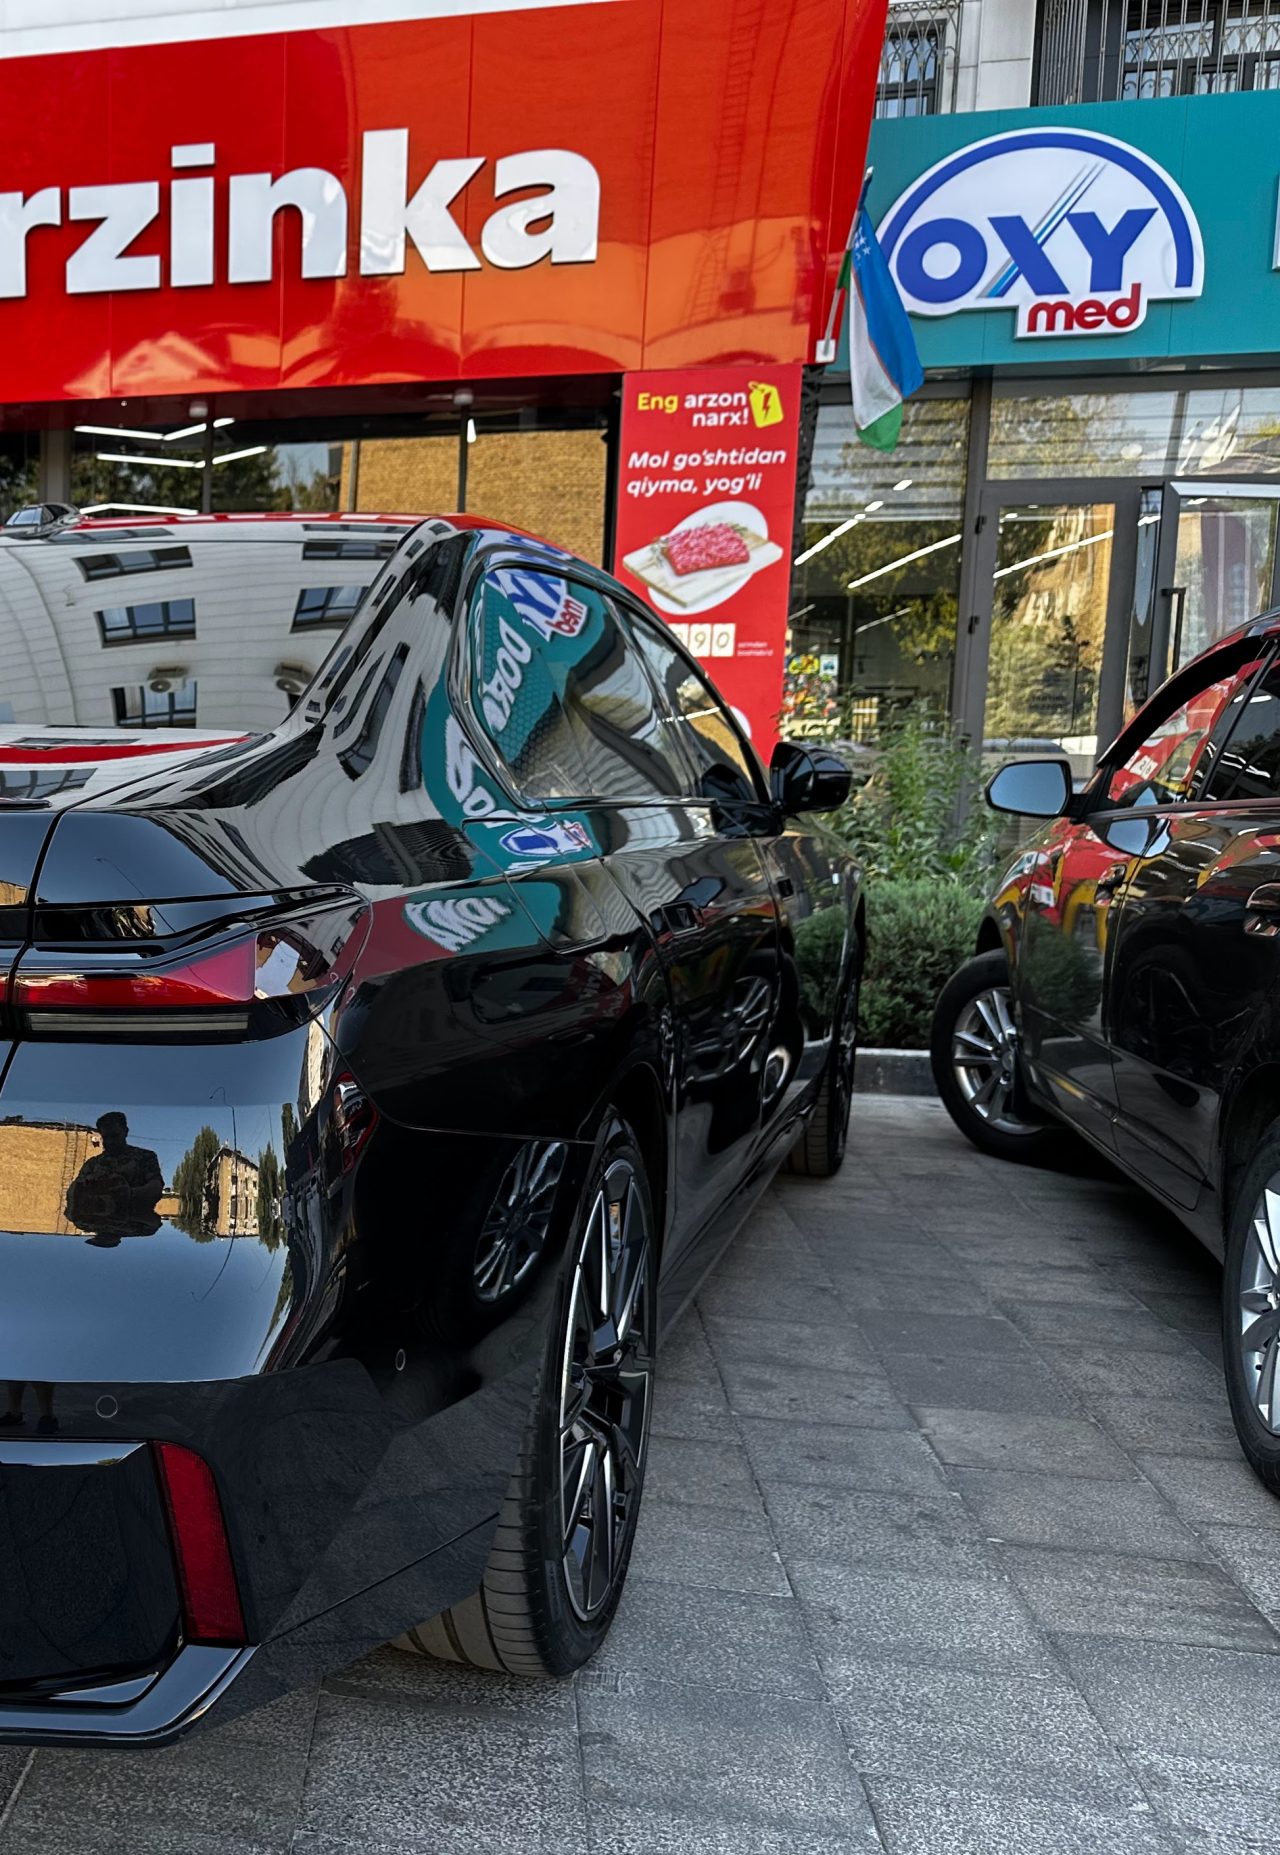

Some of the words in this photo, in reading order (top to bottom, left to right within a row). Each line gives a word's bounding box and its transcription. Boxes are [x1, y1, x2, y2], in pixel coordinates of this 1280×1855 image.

[896, 207, 1159, 304] OXY
[1027, 282, 1142, 332] med
[637, 392, 678, 413] Eng
[684, 390, 747, 408] arzon
[692, 408, 749, 427] narx!
[628, 451, 669, 469] Mol
[627, 479, 698, 497] qiyma,
